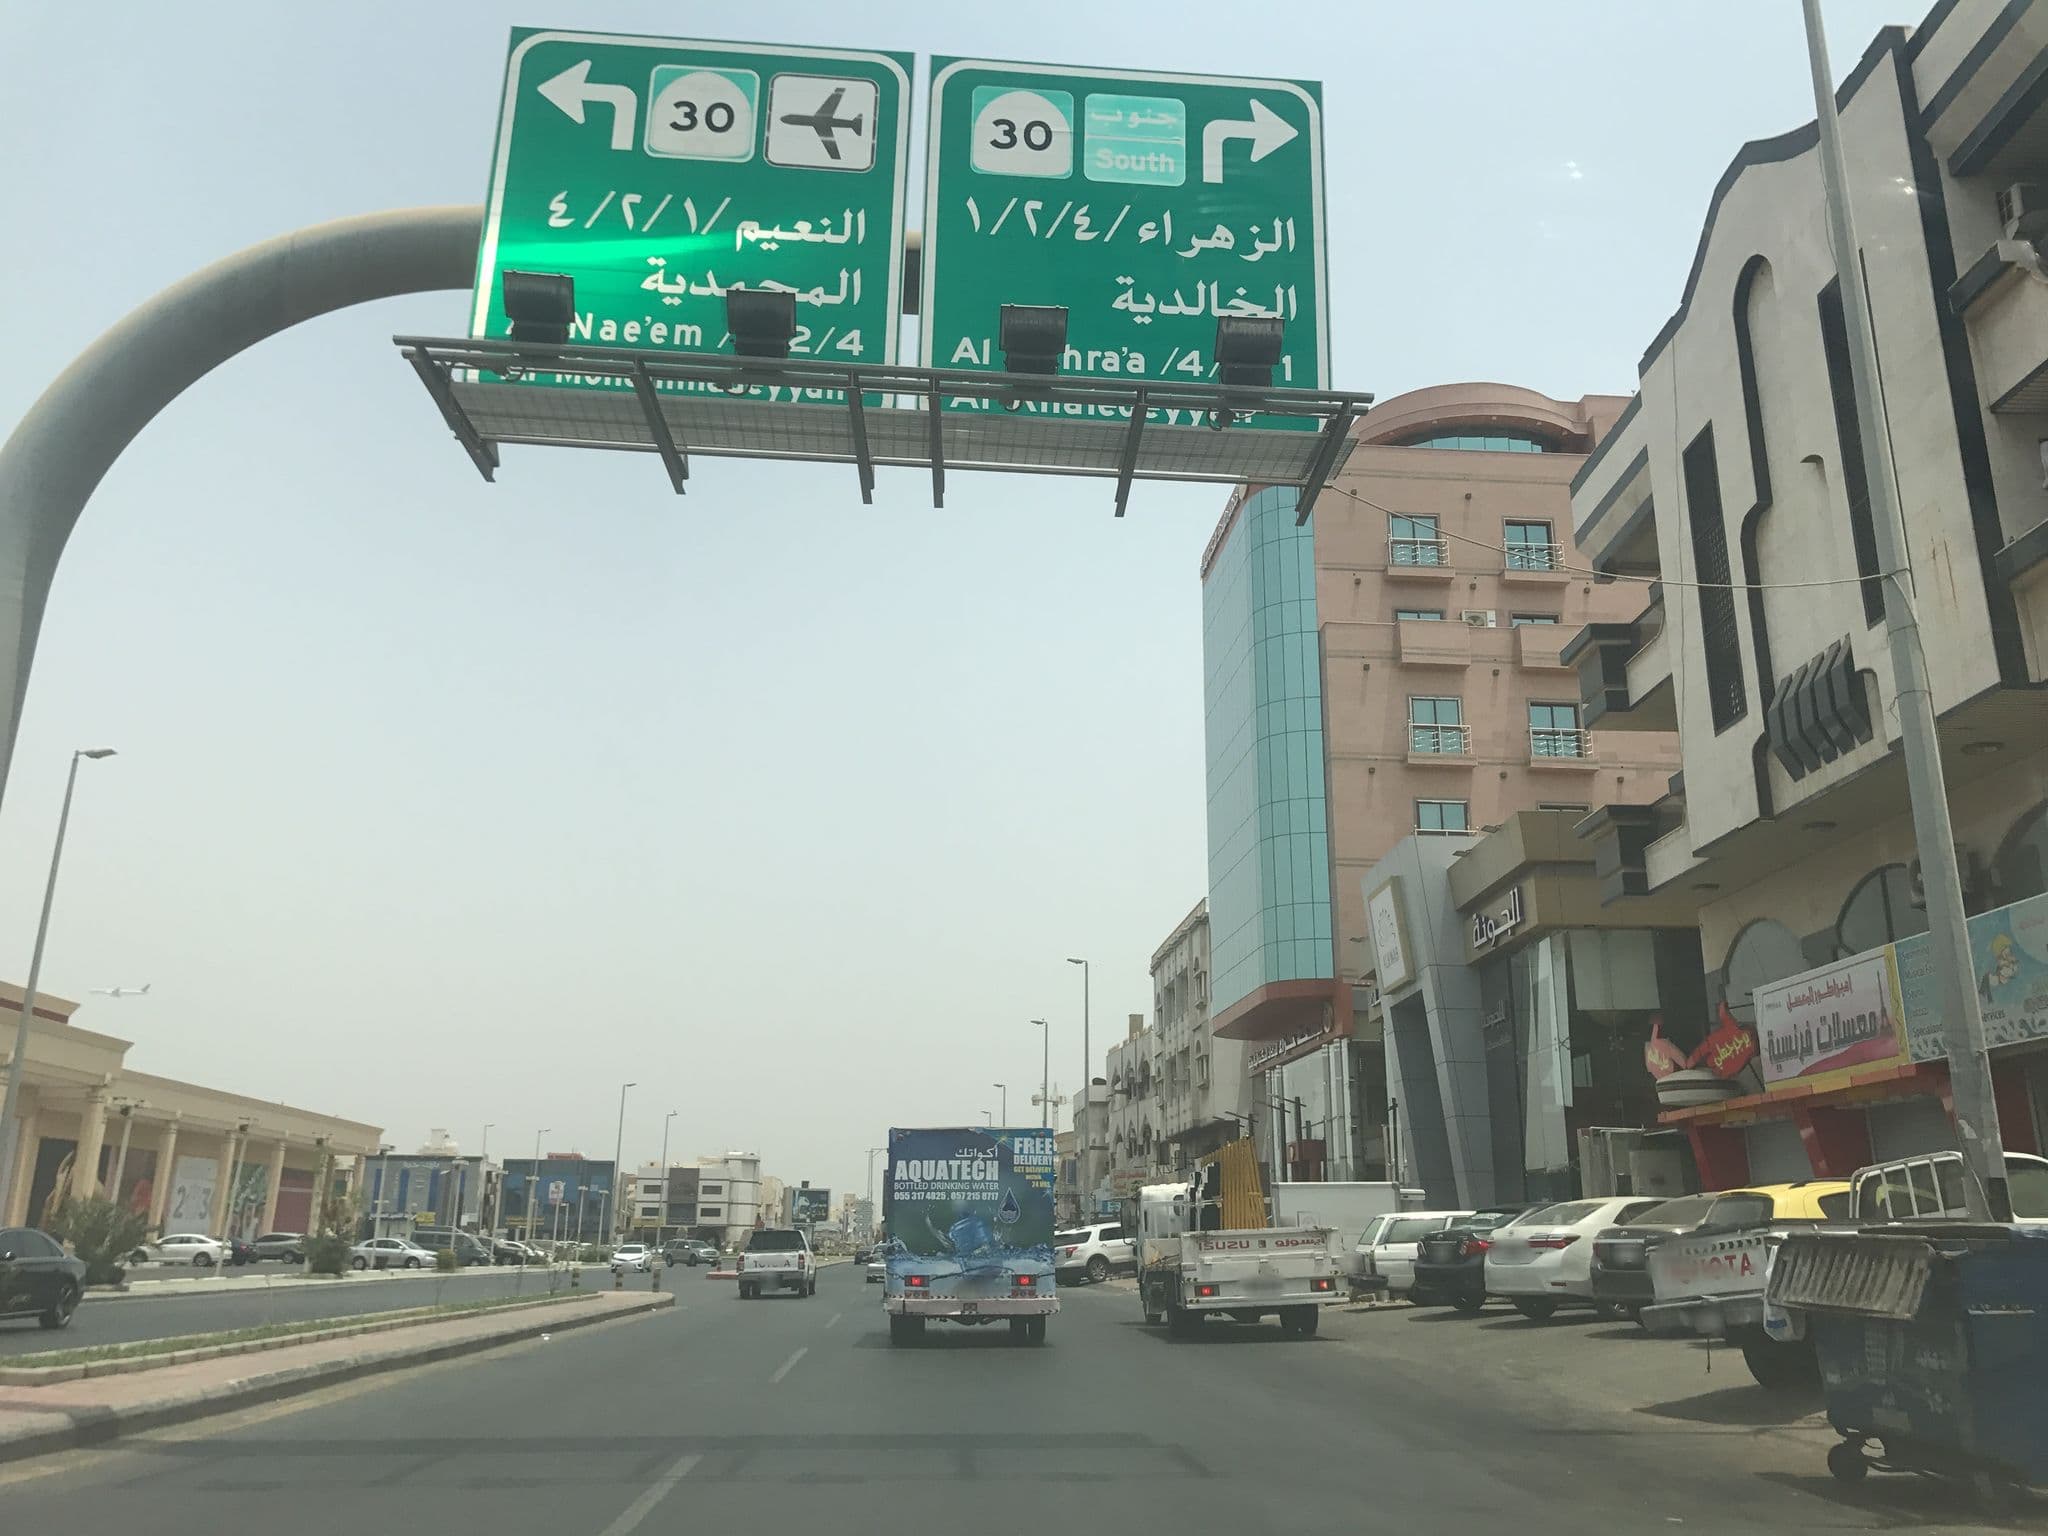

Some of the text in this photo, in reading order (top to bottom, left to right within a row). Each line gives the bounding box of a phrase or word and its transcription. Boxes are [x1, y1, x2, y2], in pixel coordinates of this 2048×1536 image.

[669, 101, 736, 133] 30
[1090, 108, 1178, 129] جنوب
[989, 118, 1053, 151] 30
[1096, 148, 1176, 174] South
[735, 208, 866, 251] النعيم
[1137, 209, 1297, 262] الزهراء
[1111, 275, 1298, 325] الخالدية
[951, 337, 990, 365] Al
[1063, 344, 1146, 374] hra'a
[1473, 886, 1521, 950] الجونة
[1767, 1020, 1814, 1073] فرنسية
[1013, 1155, 1053, 1165] DELIVERY
[1014, 1137, 1053, 1154] FREE
[894, 1182, 1000, 1190] BOTTLED DRINKING WATER
[895, 1160, 999, 1182] AQUATECH
[1199, 1240, 1250, 1251] ISUZU
